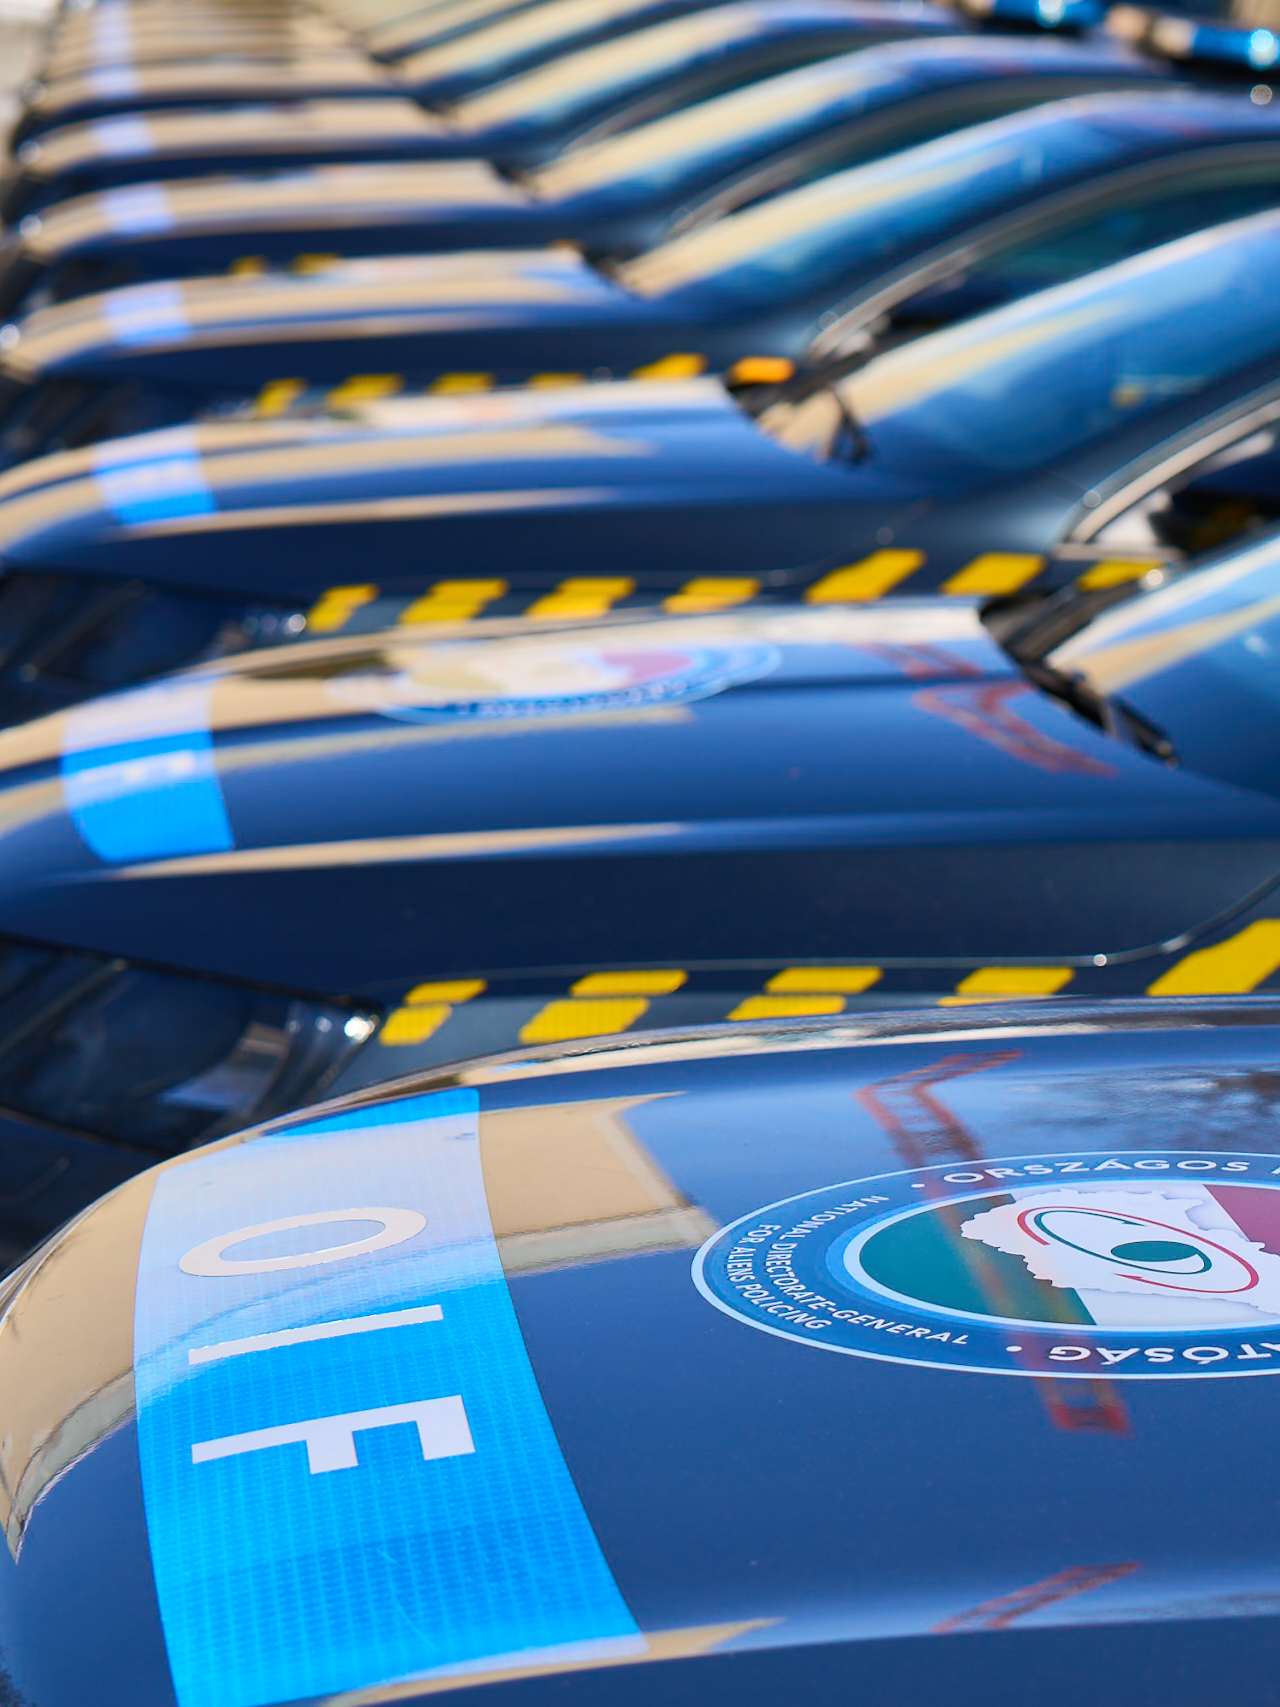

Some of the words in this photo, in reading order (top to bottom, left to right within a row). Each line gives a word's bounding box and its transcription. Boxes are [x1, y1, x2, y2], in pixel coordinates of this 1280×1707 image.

[942, 1157, 1250, 1185] ORSZÁGOS
[737, 1223, 781, 1244] FOR
[779, 1195, 890, 1241] NATIONAL
[726, 1246, 756, 1283] ALIENS
[735, 1284, 833, 1331] POLICING
[765, 1242, 970, 1346] DIRECTORATE-GENERAL
[178, 1206, 476, 1475] OIF
